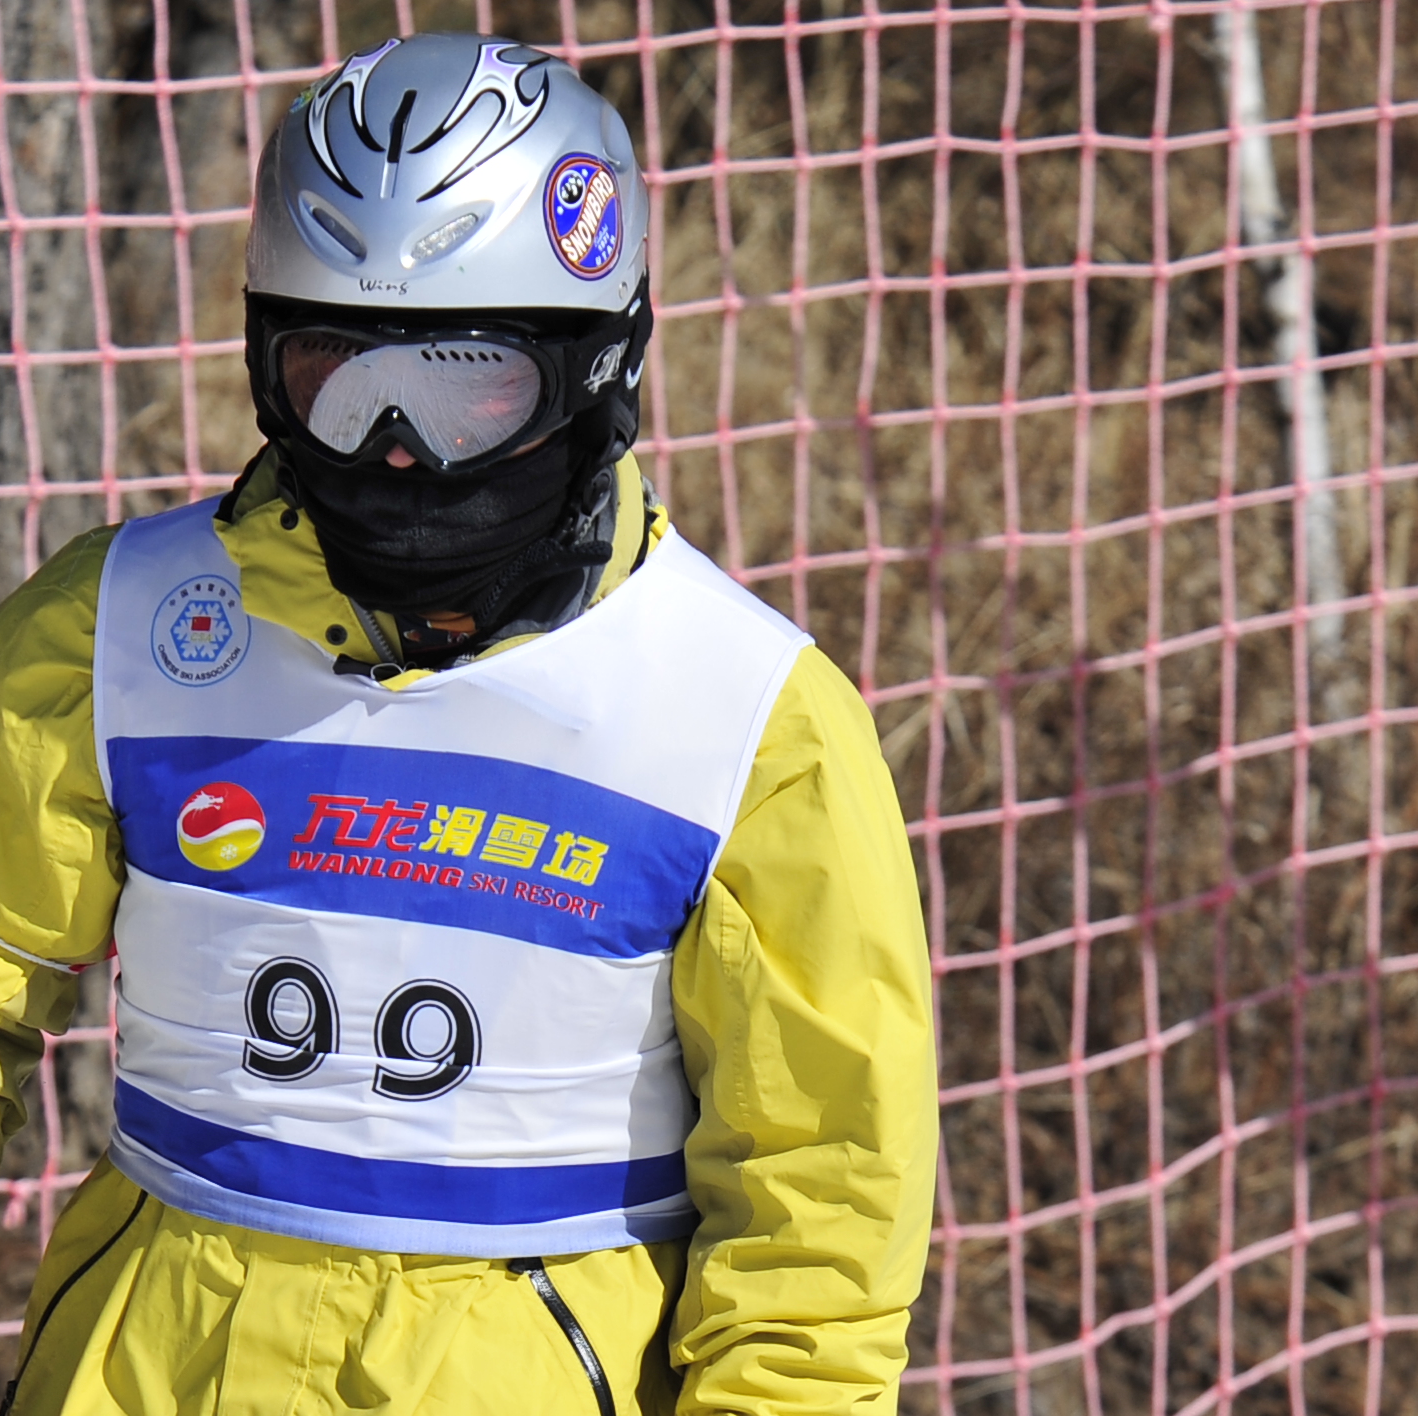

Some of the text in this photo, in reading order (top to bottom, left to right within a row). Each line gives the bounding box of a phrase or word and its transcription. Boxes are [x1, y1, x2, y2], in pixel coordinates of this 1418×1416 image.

[560, 170, 615, 262] SNOWBIRD
[359, 277, 409, 296] Wing
[157, 643, 241, 681] CHINESE SKI ASSOCIATION
[292, 793, 609, 887] 万龙滑雪场
[287, 850, 605, 921] WANLONG SKI RESORT
[242, 956, 482, 1102] 99
